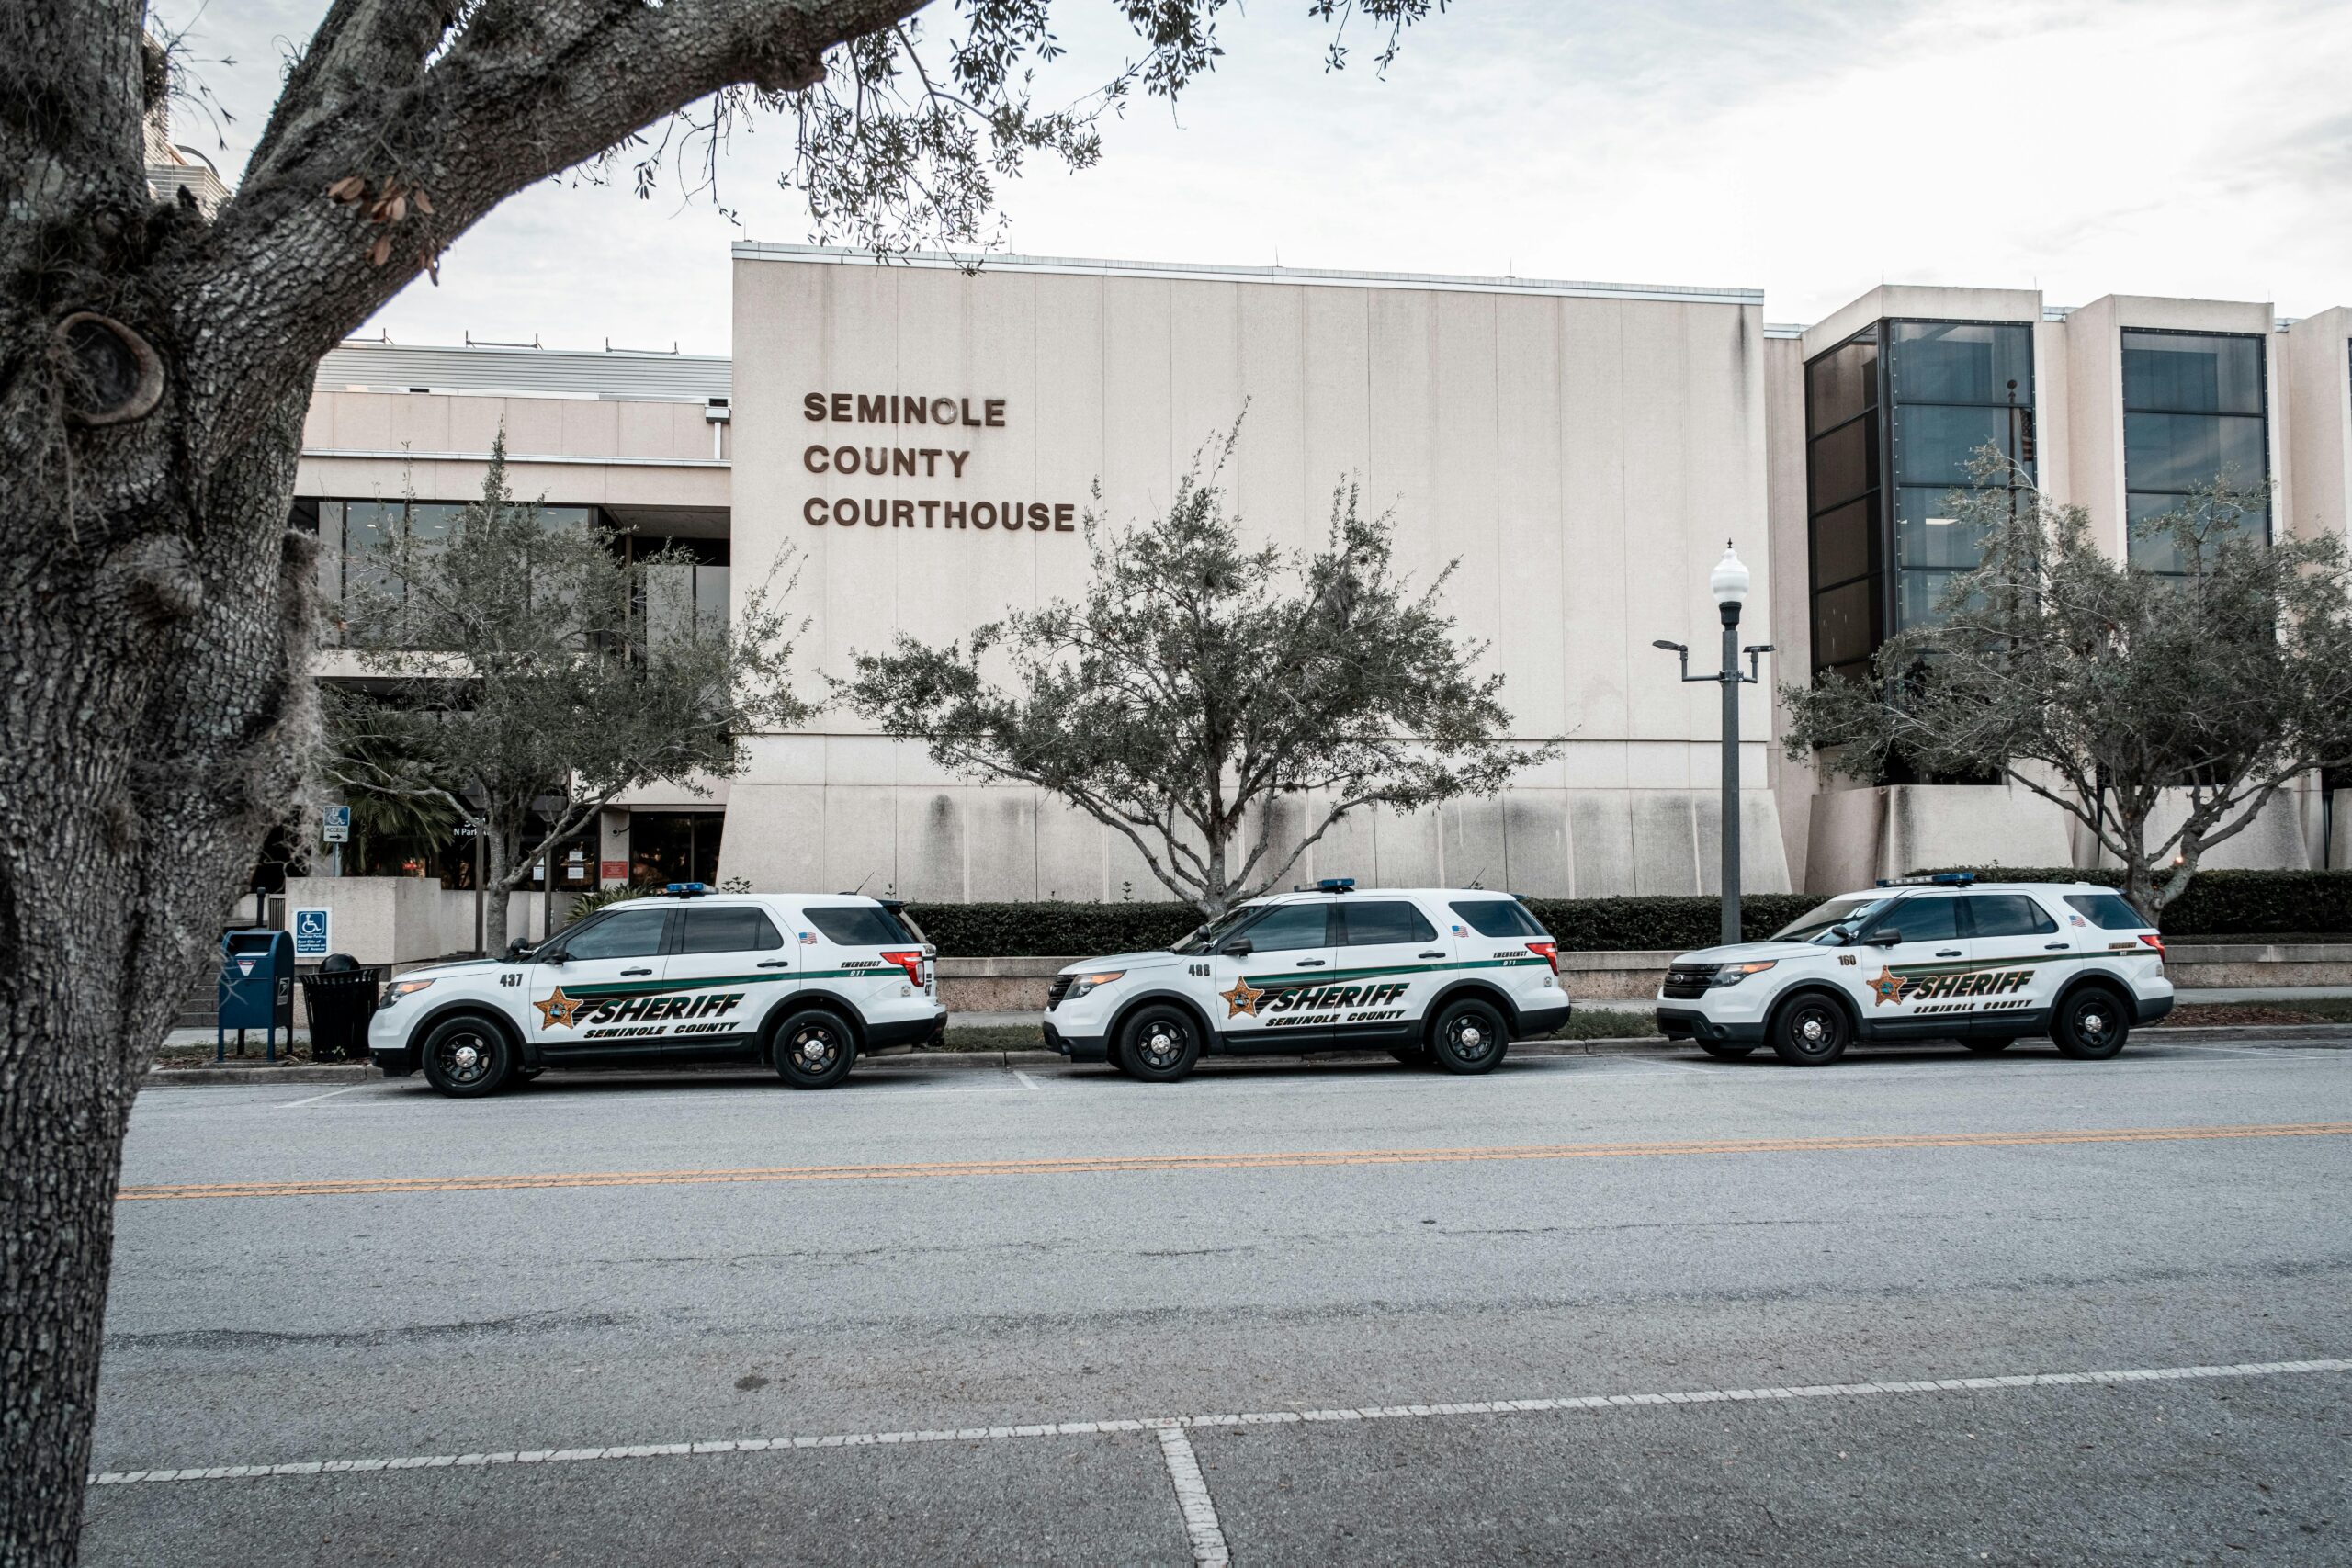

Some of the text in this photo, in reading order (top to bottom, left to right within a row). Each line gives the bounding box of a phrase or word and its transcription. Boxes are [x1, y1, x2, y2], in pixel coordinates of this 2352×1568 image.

[804, 392, 1005, 426] SEMINOLE
[804, 445, 970, 477] COUNTY
[804, 497, 1075, 531] COURTHOUSE
[841, 960, 882, 968] EMERGENCY
[1838, 954, 1857, 965] 160
[499, 974, 523, 987] 437
[1913, 970, 2036, 1000] SHERIFF
[589, 992, 746, 1024] SHERIFF
[1270, 983, 1410, 1011] SHERIFF
[1913, 999, 2033, 1014] SEMINOLE COUNTY
[583, 1021, 740, 1039] SEMINOLE COUNTY
[1265, 1010, 1407, 1027] SEMINOLE COUNTY
